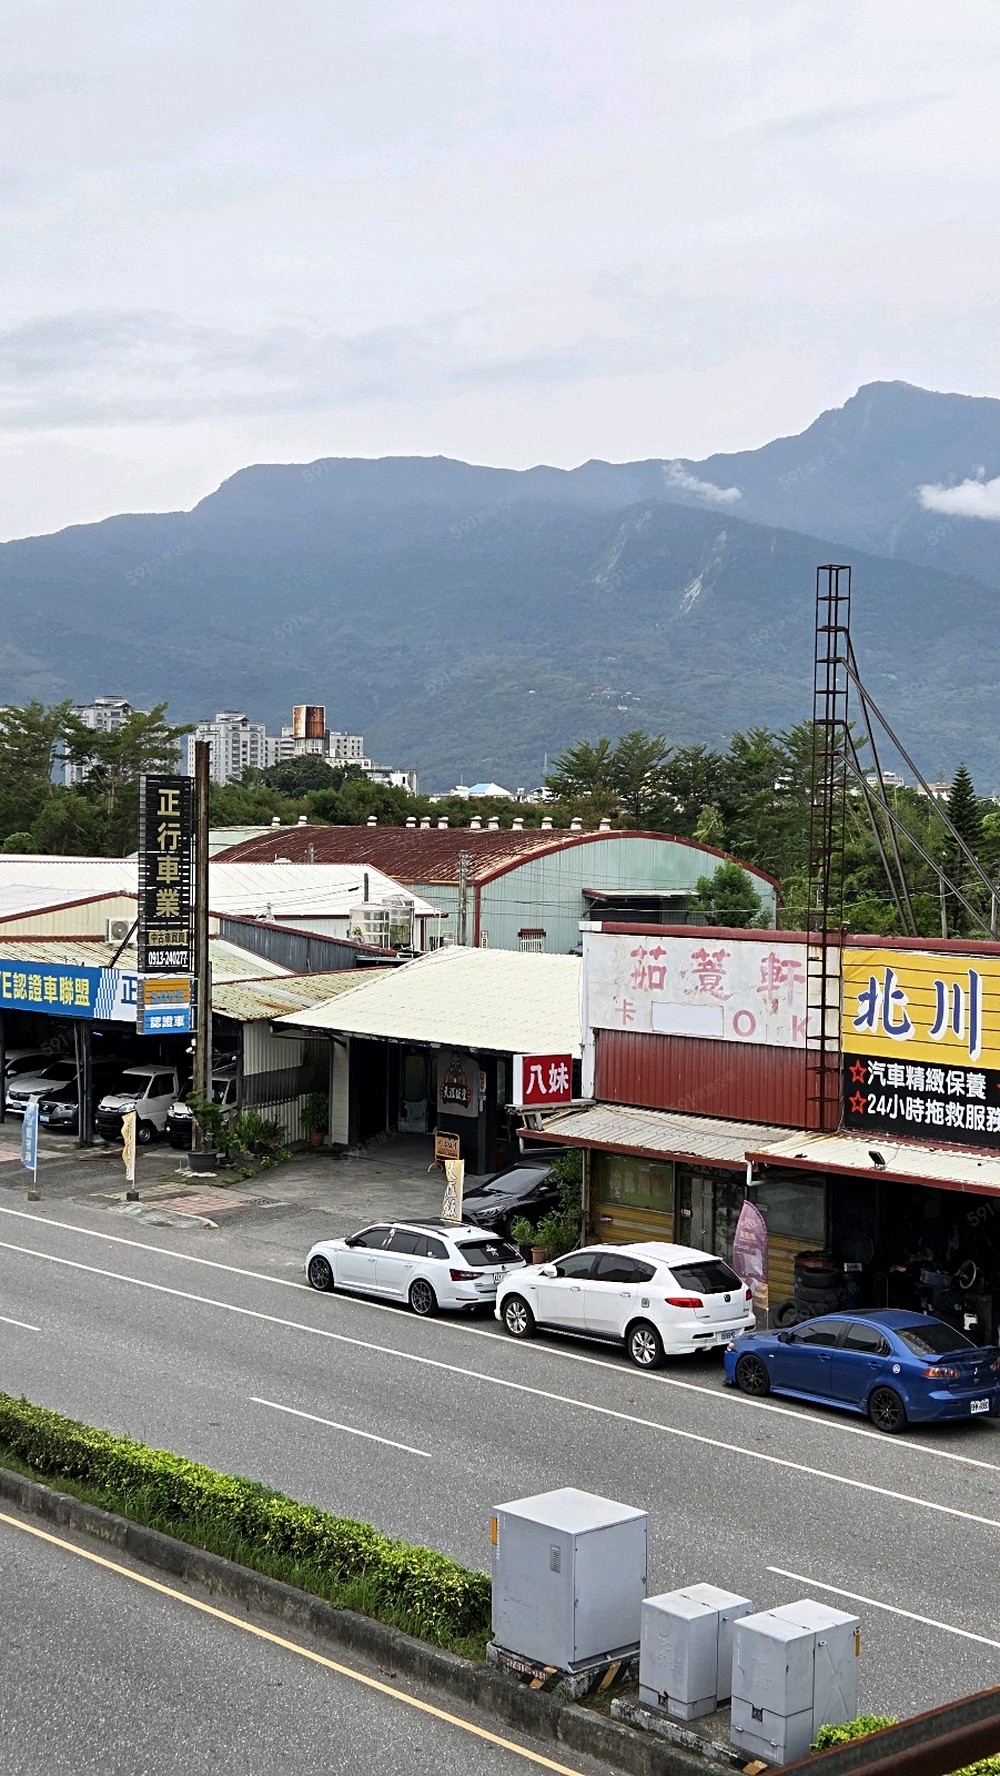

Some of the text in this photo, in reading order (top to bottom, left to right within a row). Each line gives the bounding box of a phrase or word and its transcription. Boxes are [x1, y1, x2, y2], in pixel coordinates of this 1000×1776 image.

[156, 788, 181, 917] 正行車業
[0, 970, 90, 1007] E認證車聯盟
[150, 1015, 185, 1028] 認證車
[853, 967, 982, 1061] 北川
[526, 1062, 568, 1094] 八妹
[867, 1060, 986, 1099] 汽車精緻保養
[867, 1093, 1000, 1133] 24小時拖救服務
